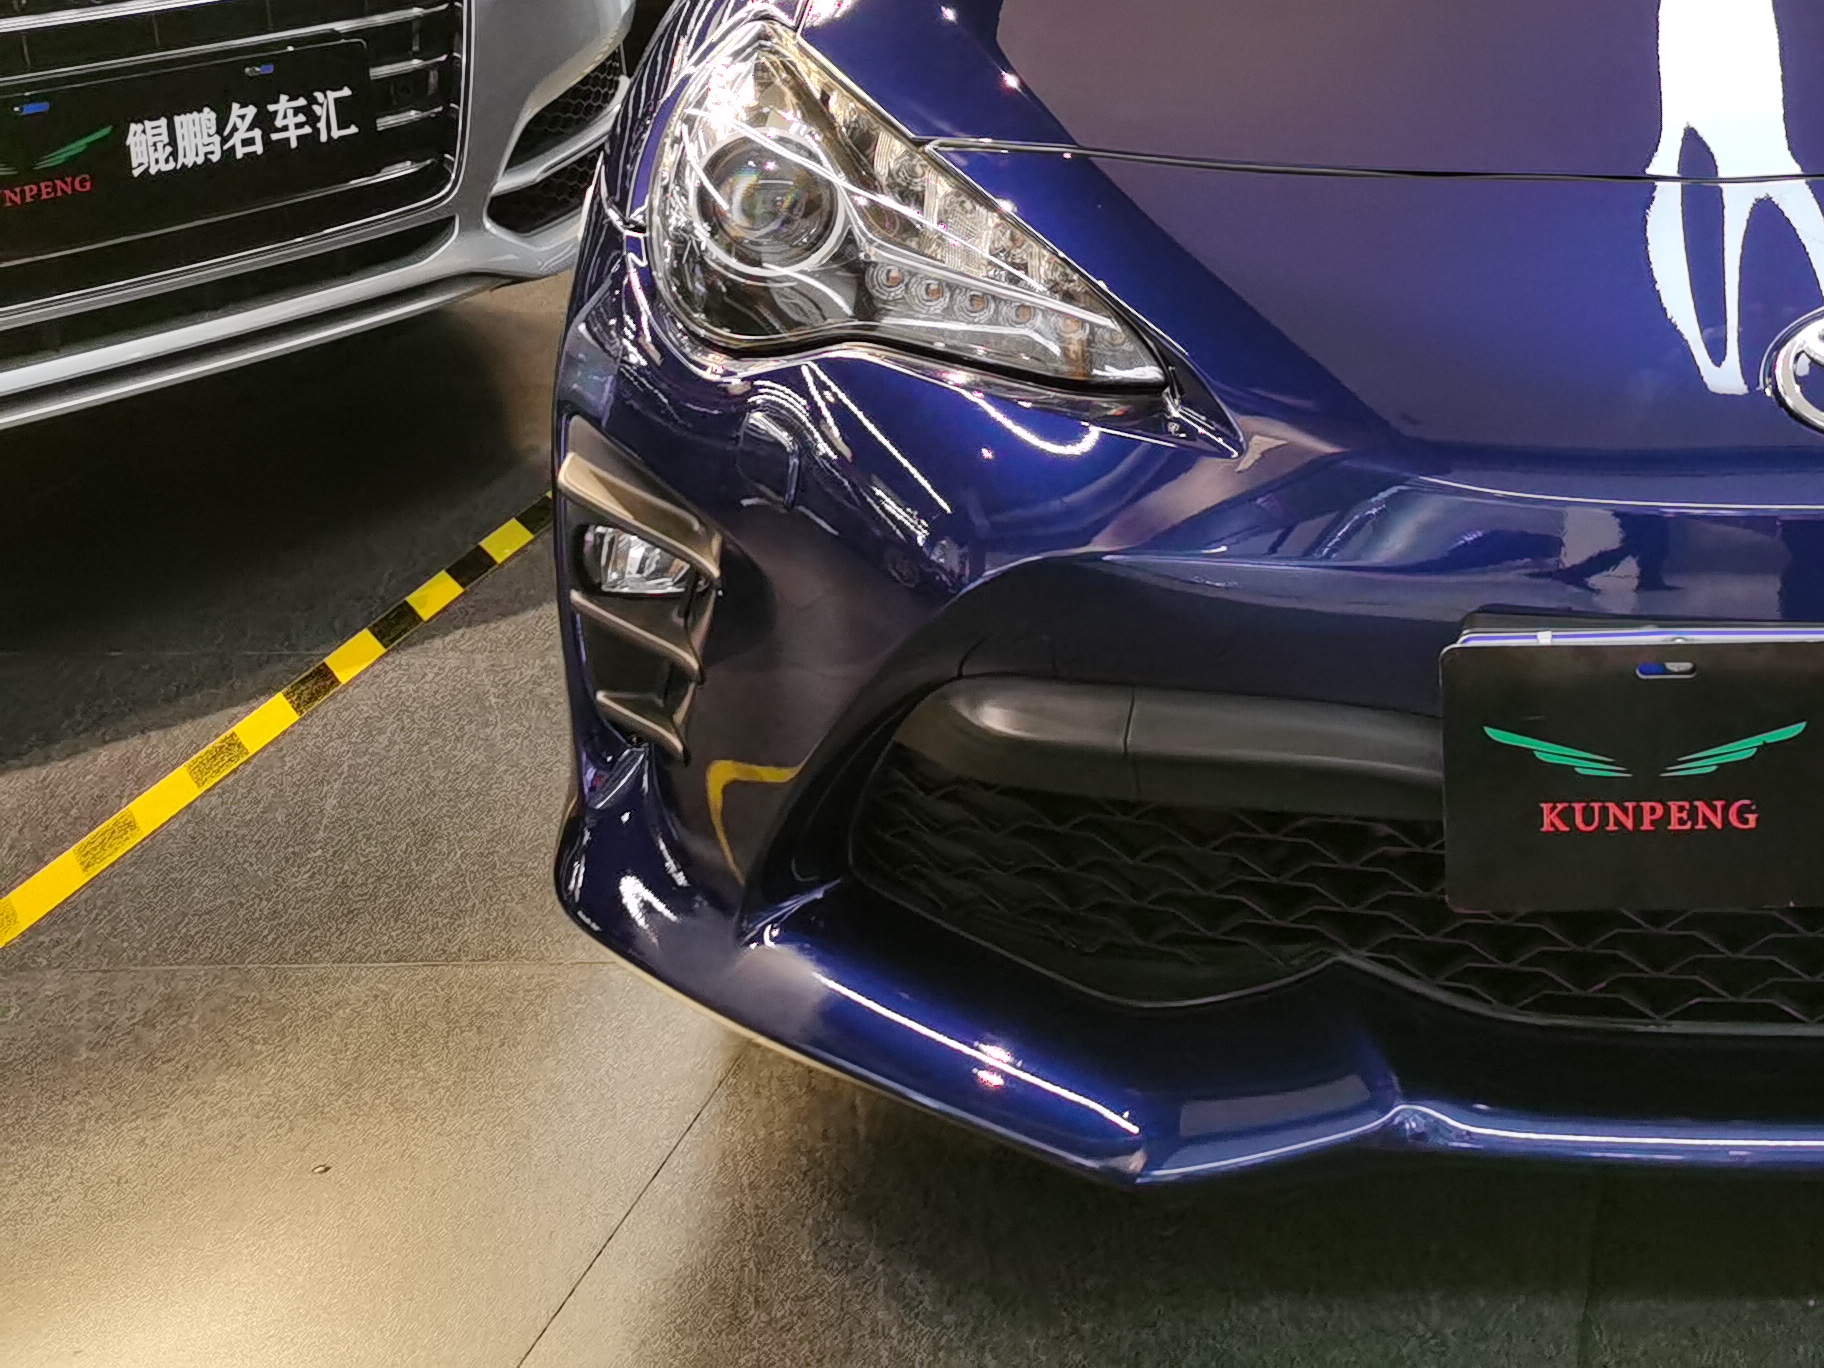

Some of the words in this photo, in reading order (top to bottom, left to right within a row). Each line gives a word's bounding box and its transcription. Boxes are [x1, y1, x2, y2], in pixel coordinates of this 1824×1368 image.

[126, 85, 359, 178] 鲲鹏名车汇
[0, 173, 92, 207] NPENG
[1539, 798, 1760, 833] KUNPENG
